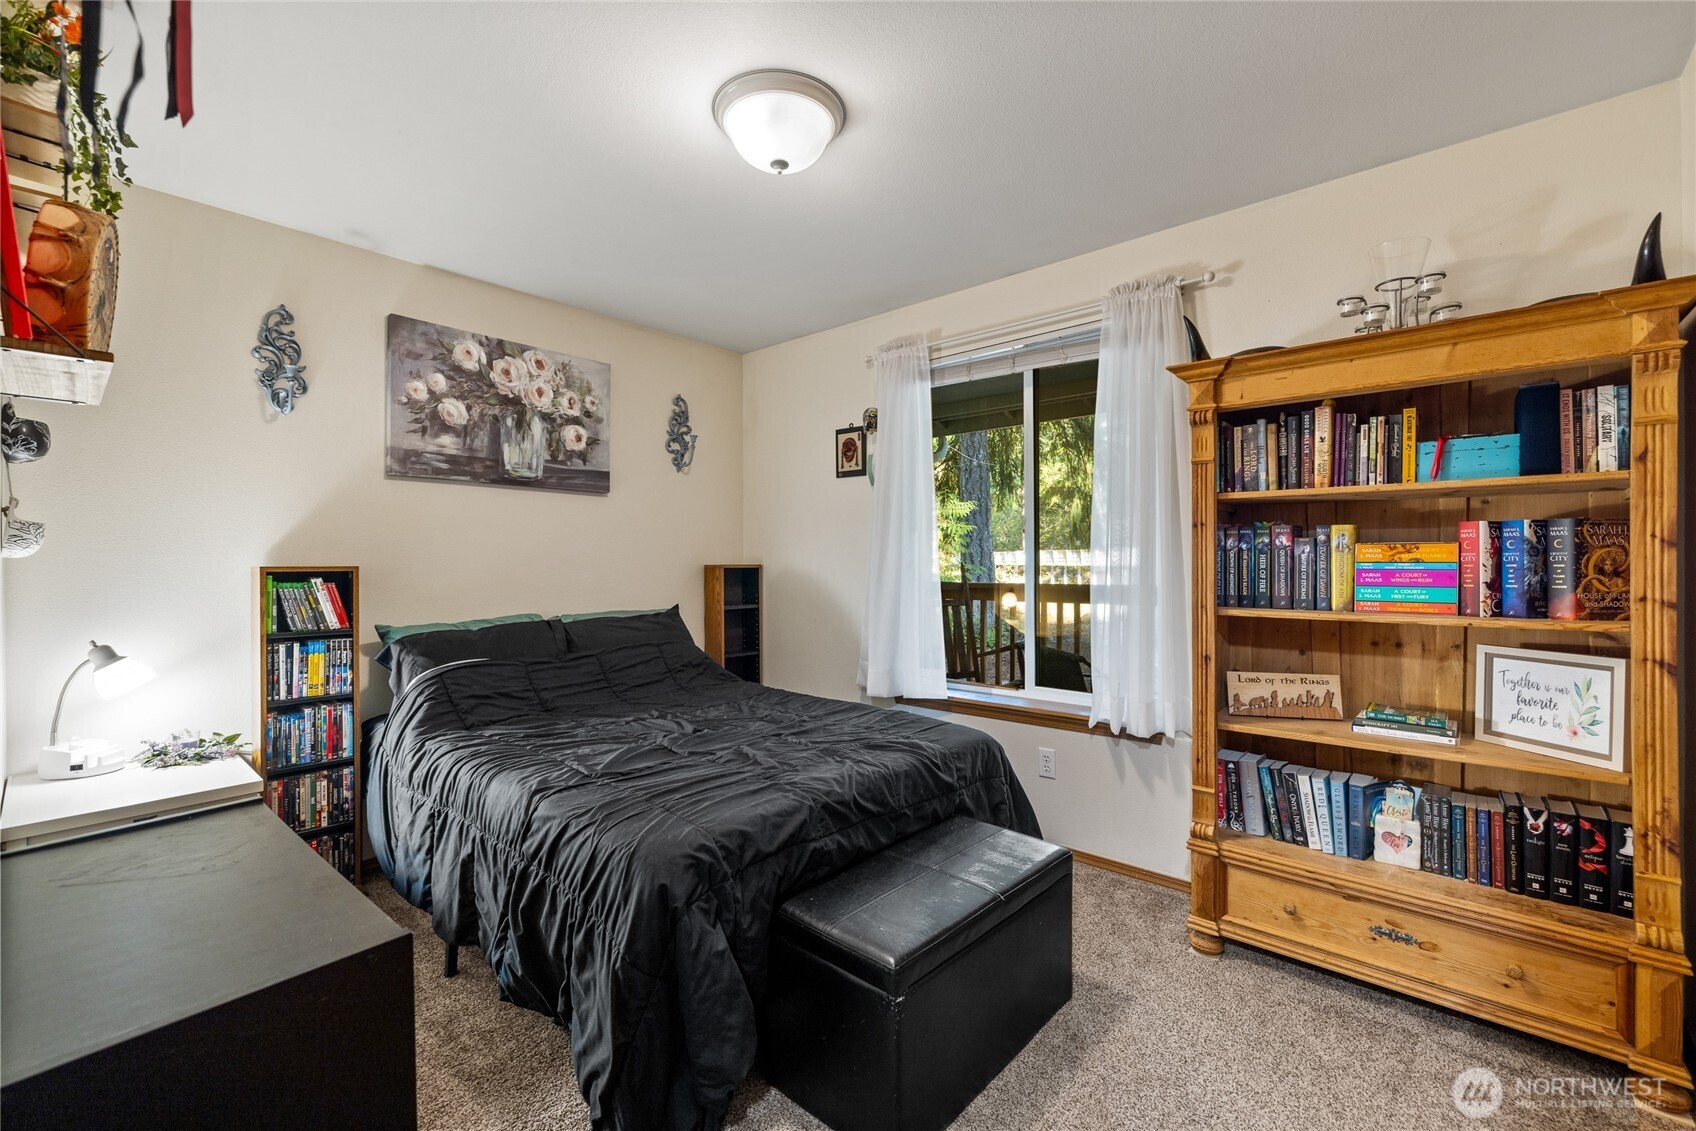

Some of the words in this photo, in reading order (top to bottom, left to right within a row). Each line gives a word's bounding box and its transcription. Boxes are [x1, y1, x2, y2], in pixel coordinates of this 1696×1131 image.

[1602, 414, 1612, 442] SOLITARY
[1587, 525, 1619, 534] SARAH
[1593, 536, 1624, 545] MAAS
[1260, 569, 1266, 578] OF
[1498, 670, 1541, 691] Together
[1545, 684, 1552, 692] is
[1555, 686, 1570, 695] our
[1517, 691, 1559, 711] favorite
[1508, 708, 1535, 724] place
[1538, 714, 1548, 727] to
[1552, 714, 1563, 730] be
[1289, 794, 1298, 810] ONYX
[1320, 814, 1330, 846] QUEEN
[1584, 854, 1603, 862] eclipse
